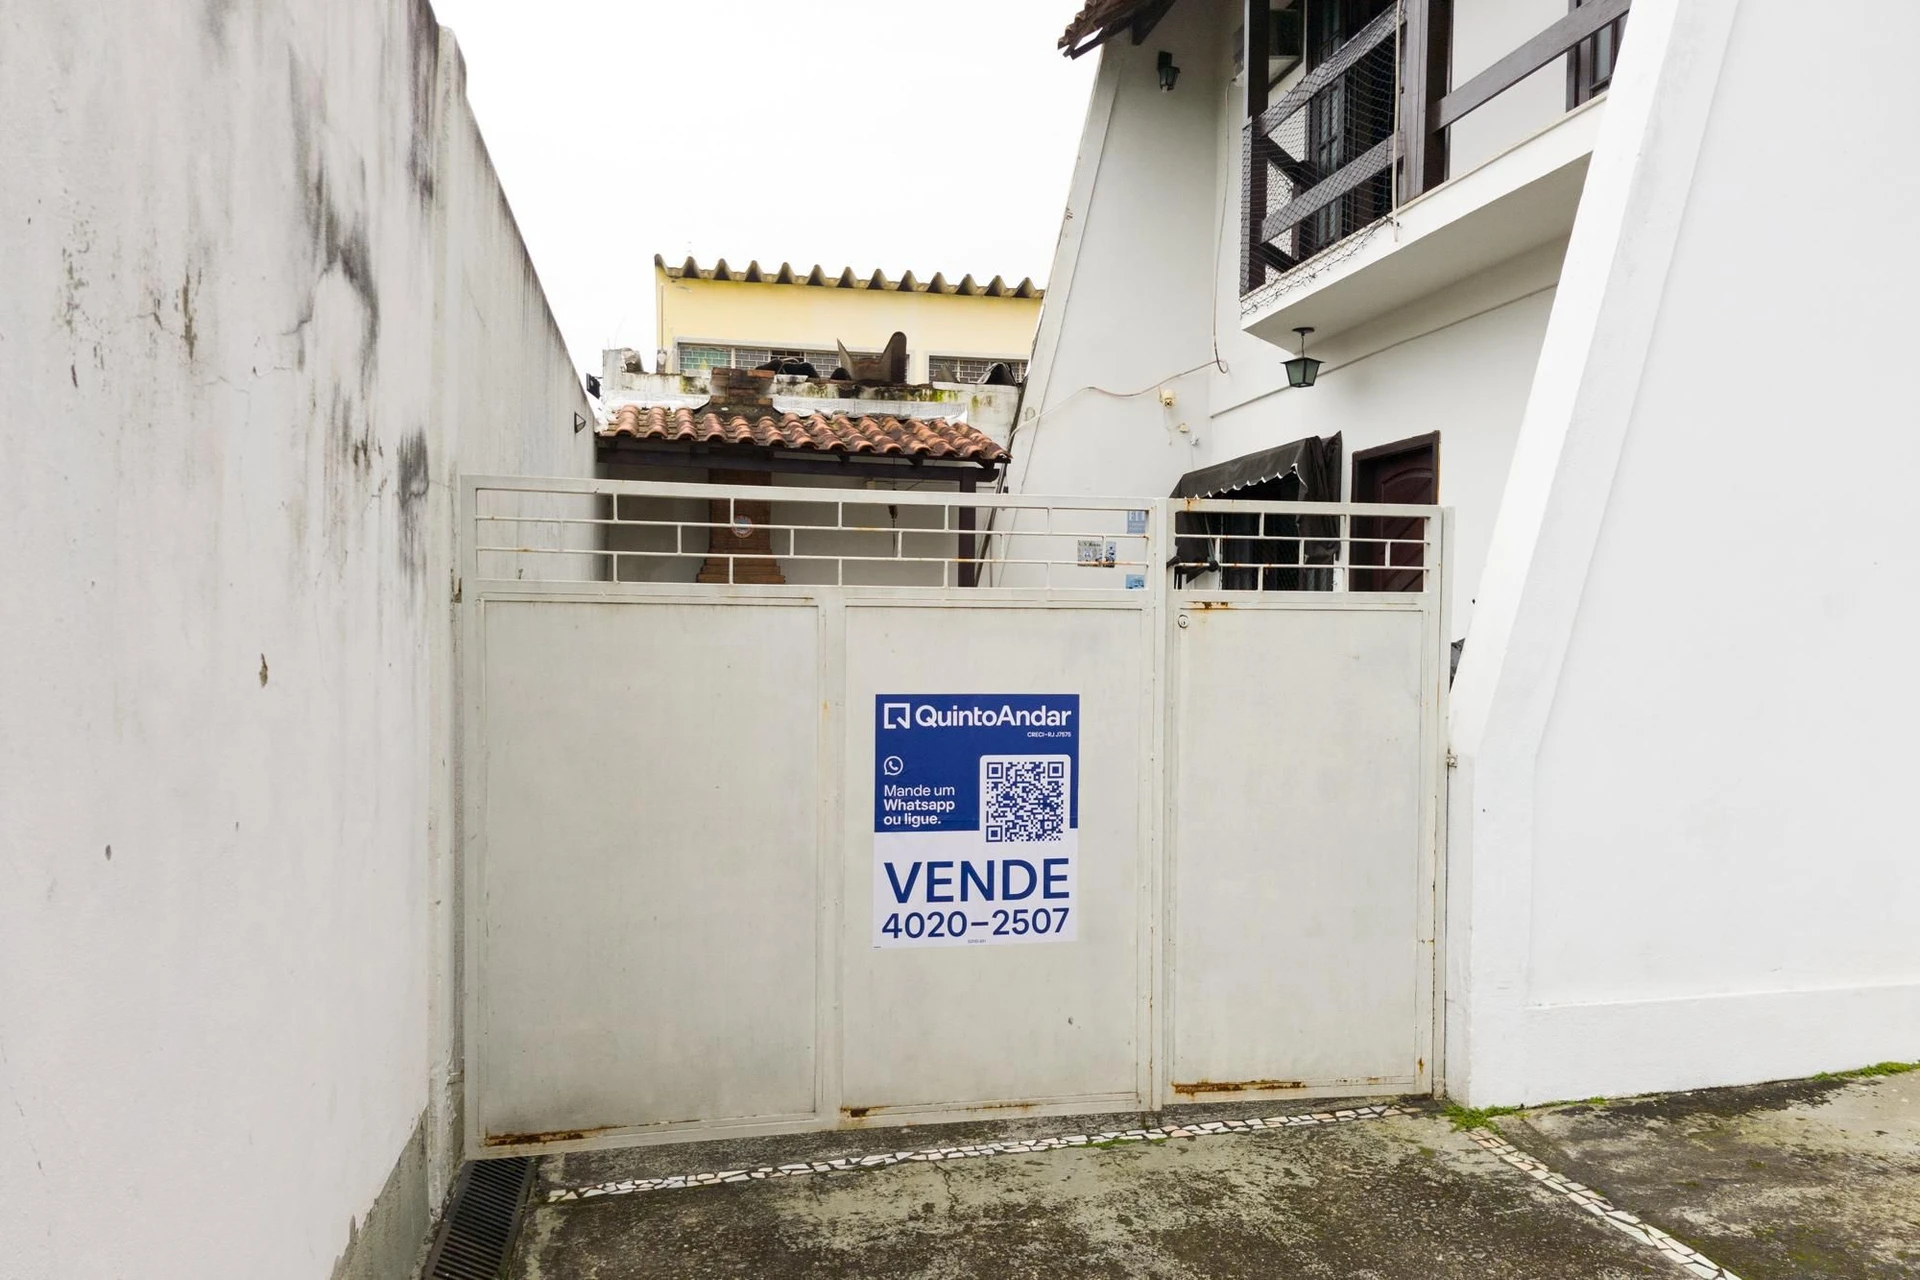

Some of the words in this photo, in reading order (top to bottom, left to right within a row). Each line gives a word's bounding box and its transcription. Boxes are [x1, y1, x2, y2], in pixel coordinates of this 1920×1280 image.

[915, 704, 1072, 728] QuintoAndar
[883, 784, 931, 797] Mande
[933, 786, 955, 796] um
[883, 798, 956, 813] Whatsapp
[883, 815, 901, 826] ou
[904, 812, 942, 827] ligue.
[883, 857, 1070, 904] VENDE
[881, 907, 1070, 939] 4020-2507
